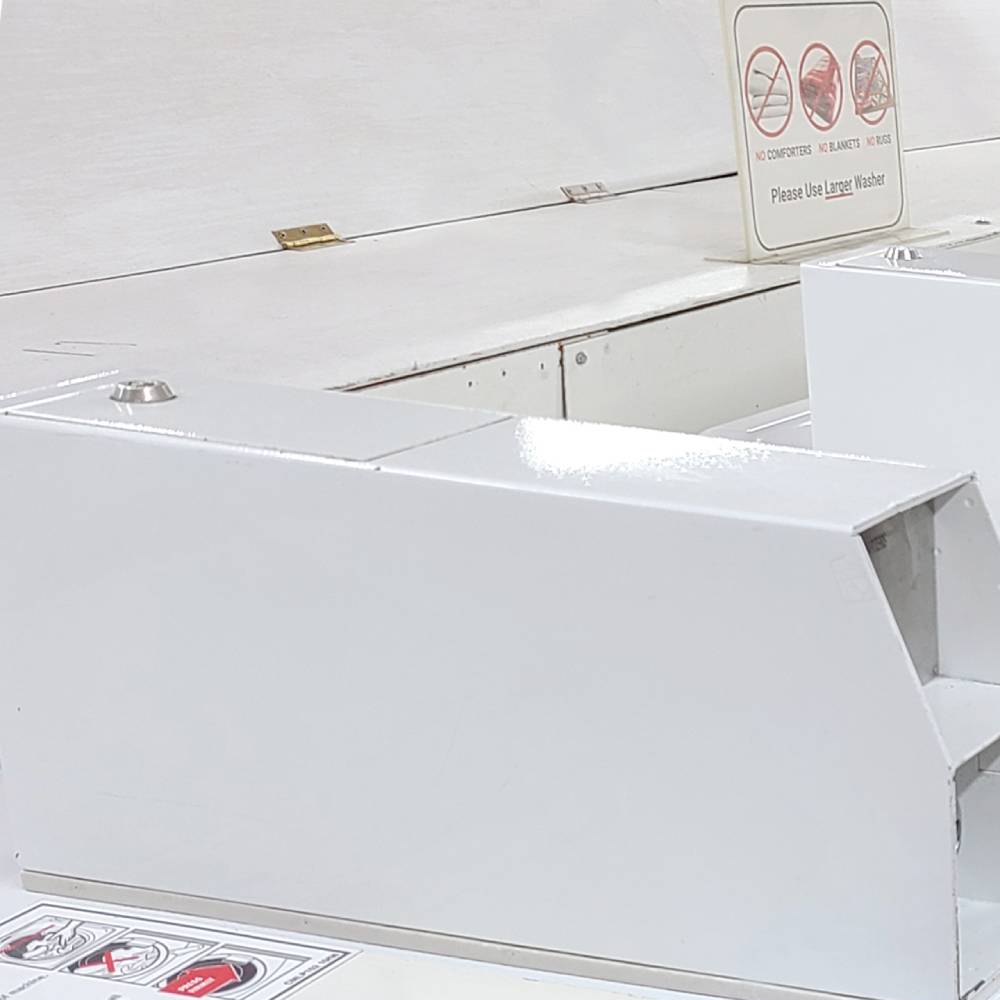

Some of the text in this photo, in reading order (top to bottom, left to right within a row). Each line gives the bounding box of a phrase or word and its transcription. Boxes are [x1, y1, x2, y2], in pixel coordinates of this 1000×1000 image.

[819, 138, 860, 153] NO BLANKETS
[866, 134, 892, 146] NO RUGS
[756, 144, 812, 160] NO COMFORTERS
[771, 171, 885, 204] Please Use Larger Washer
